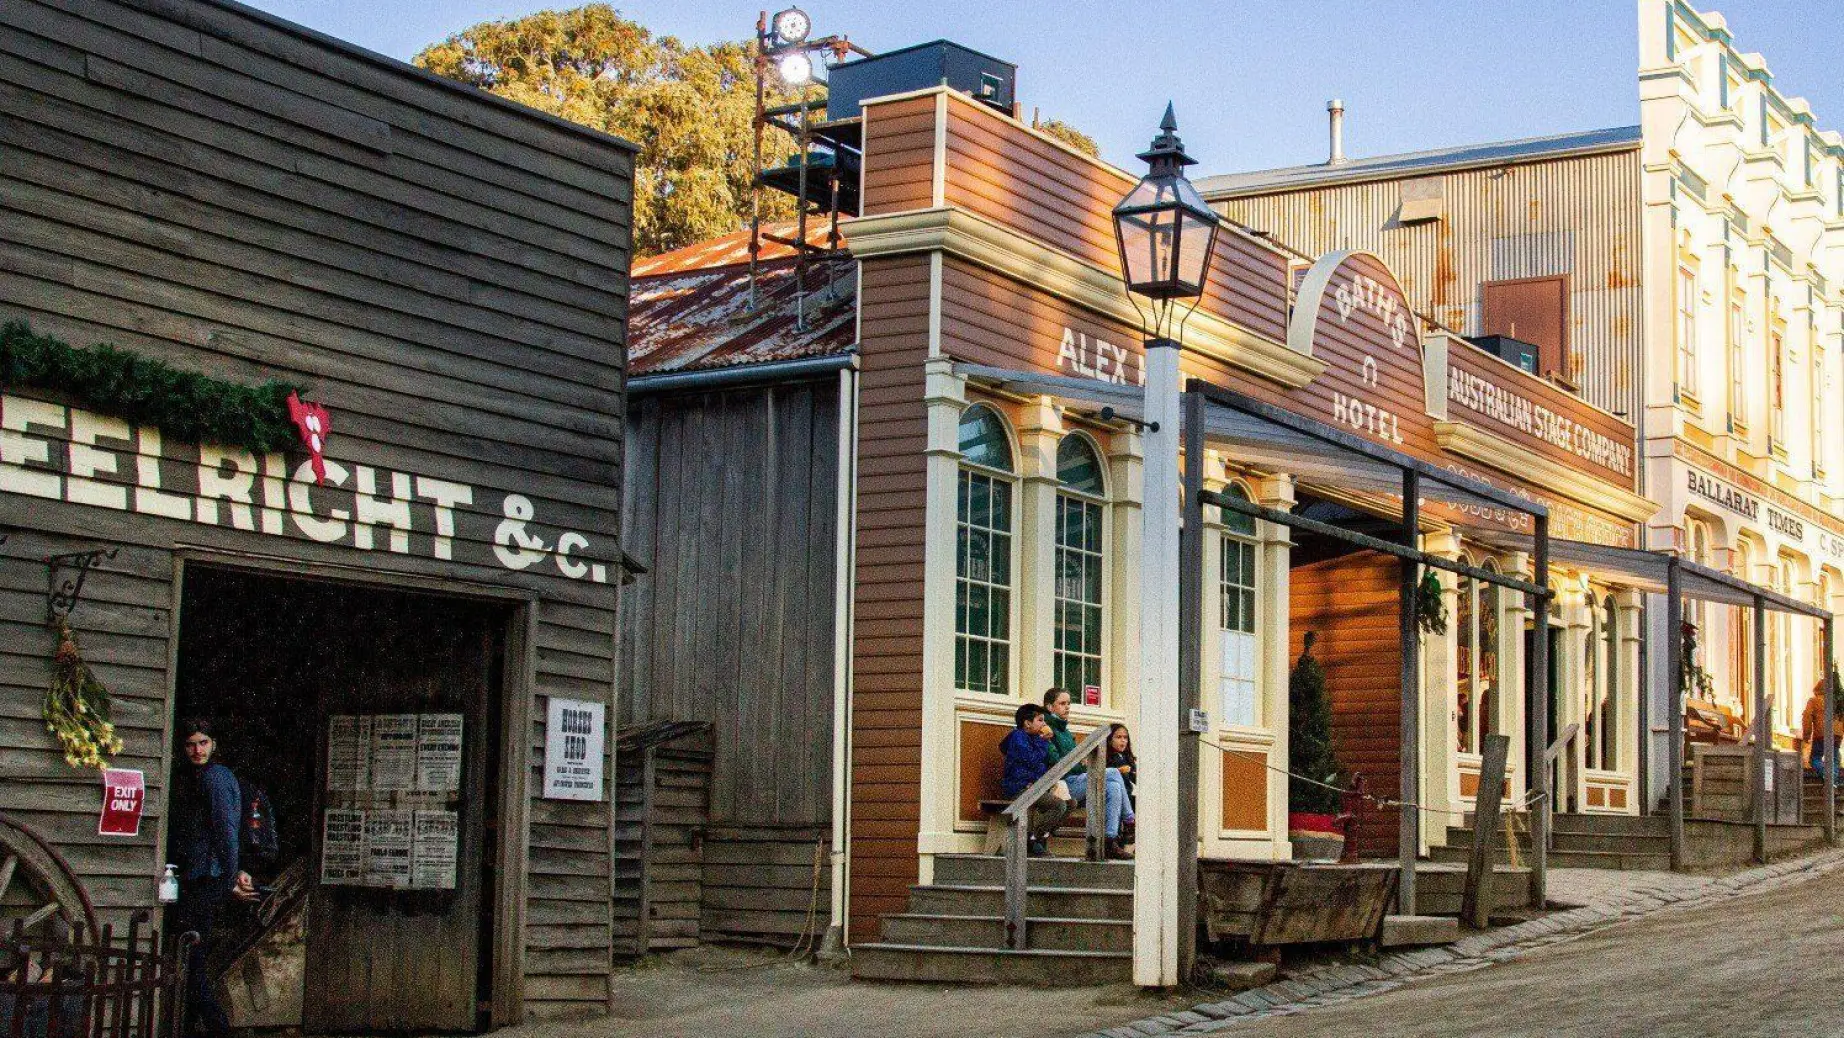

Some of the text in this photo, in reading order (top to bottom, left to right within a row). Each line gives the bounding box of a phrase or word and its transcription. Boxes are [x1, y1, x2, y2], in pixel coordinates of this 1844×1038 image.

[1056, 327, 1128, 385] ALEX
[1333, 392, 1404, 445] HOTEL
[1449, 366, 1632, 478] AUSTRALIAN STAGE COMPANY
[1687, 470, 1804, 541] BALLARAT TIMES
[111, 799, 137, 811] ONLY
[114, 786, 137, 798] EXIT
